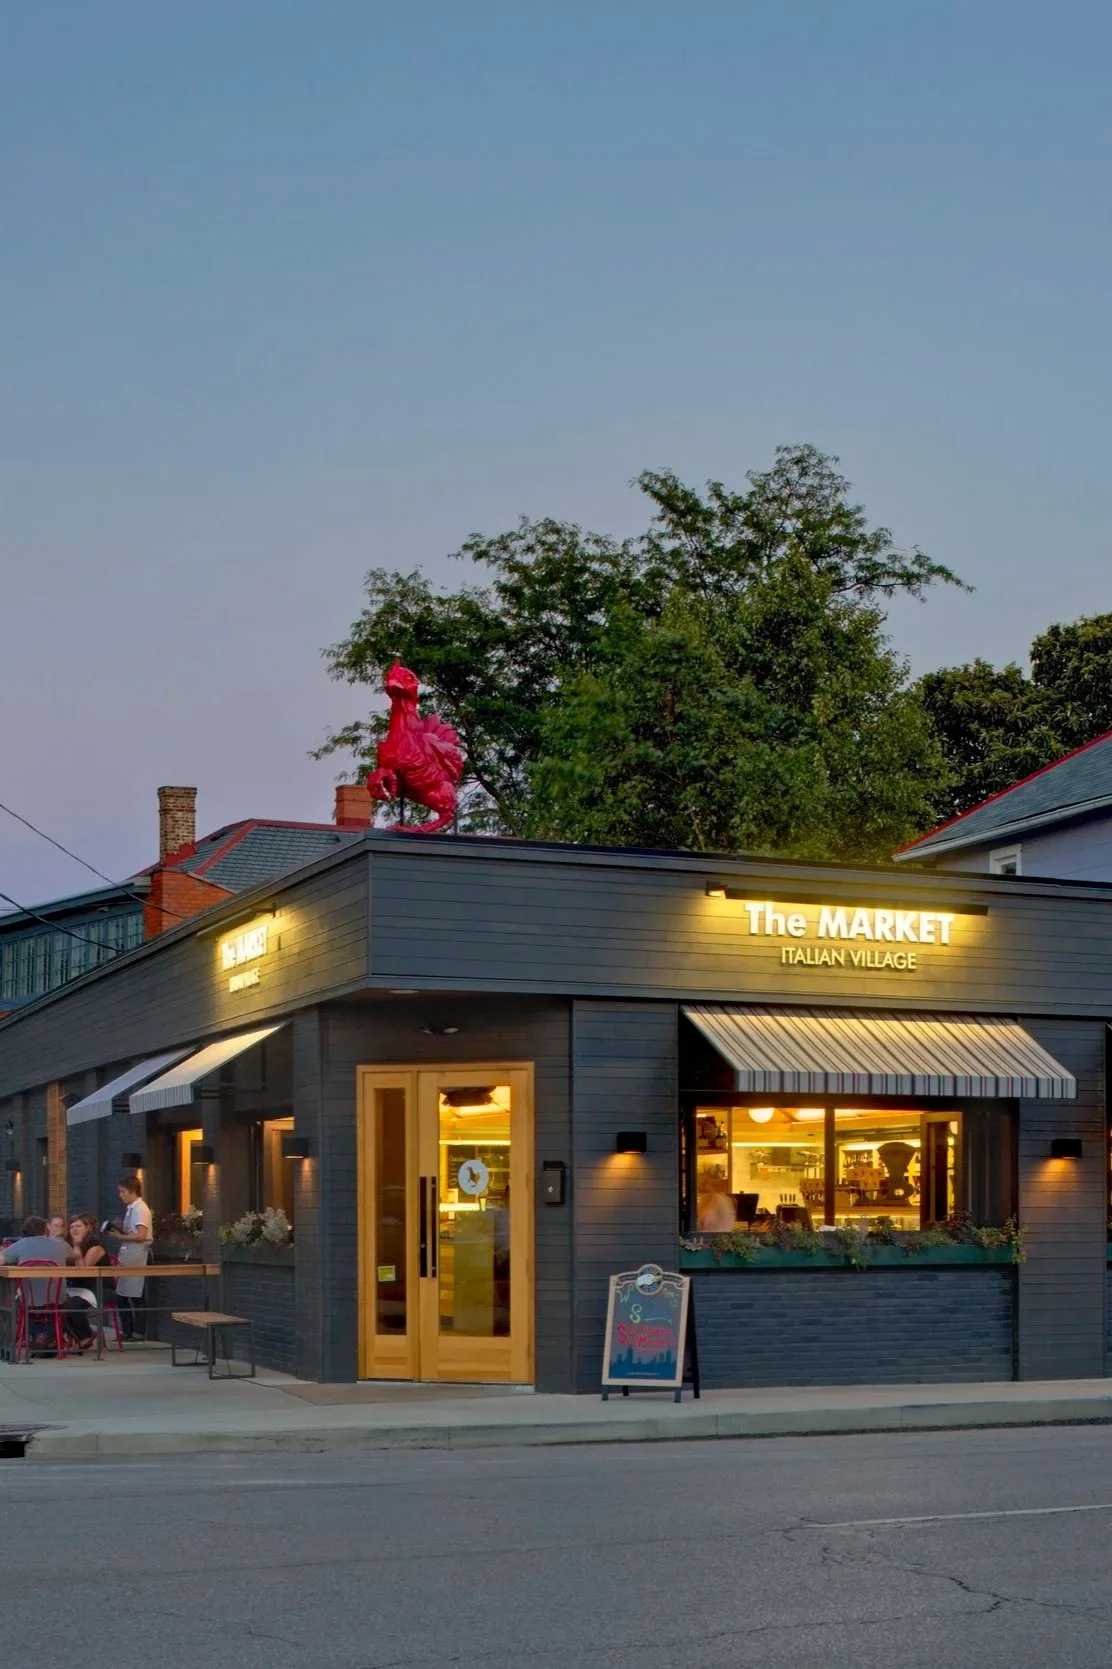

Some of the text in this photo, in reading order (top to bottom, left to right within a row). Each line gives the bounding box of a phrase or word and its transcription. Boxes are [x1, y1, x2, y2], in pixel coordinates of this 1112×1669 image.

[744, 902, 954, 944] The MARKET
[780, 947, 917, 971] ITALIAN VILLAGE
